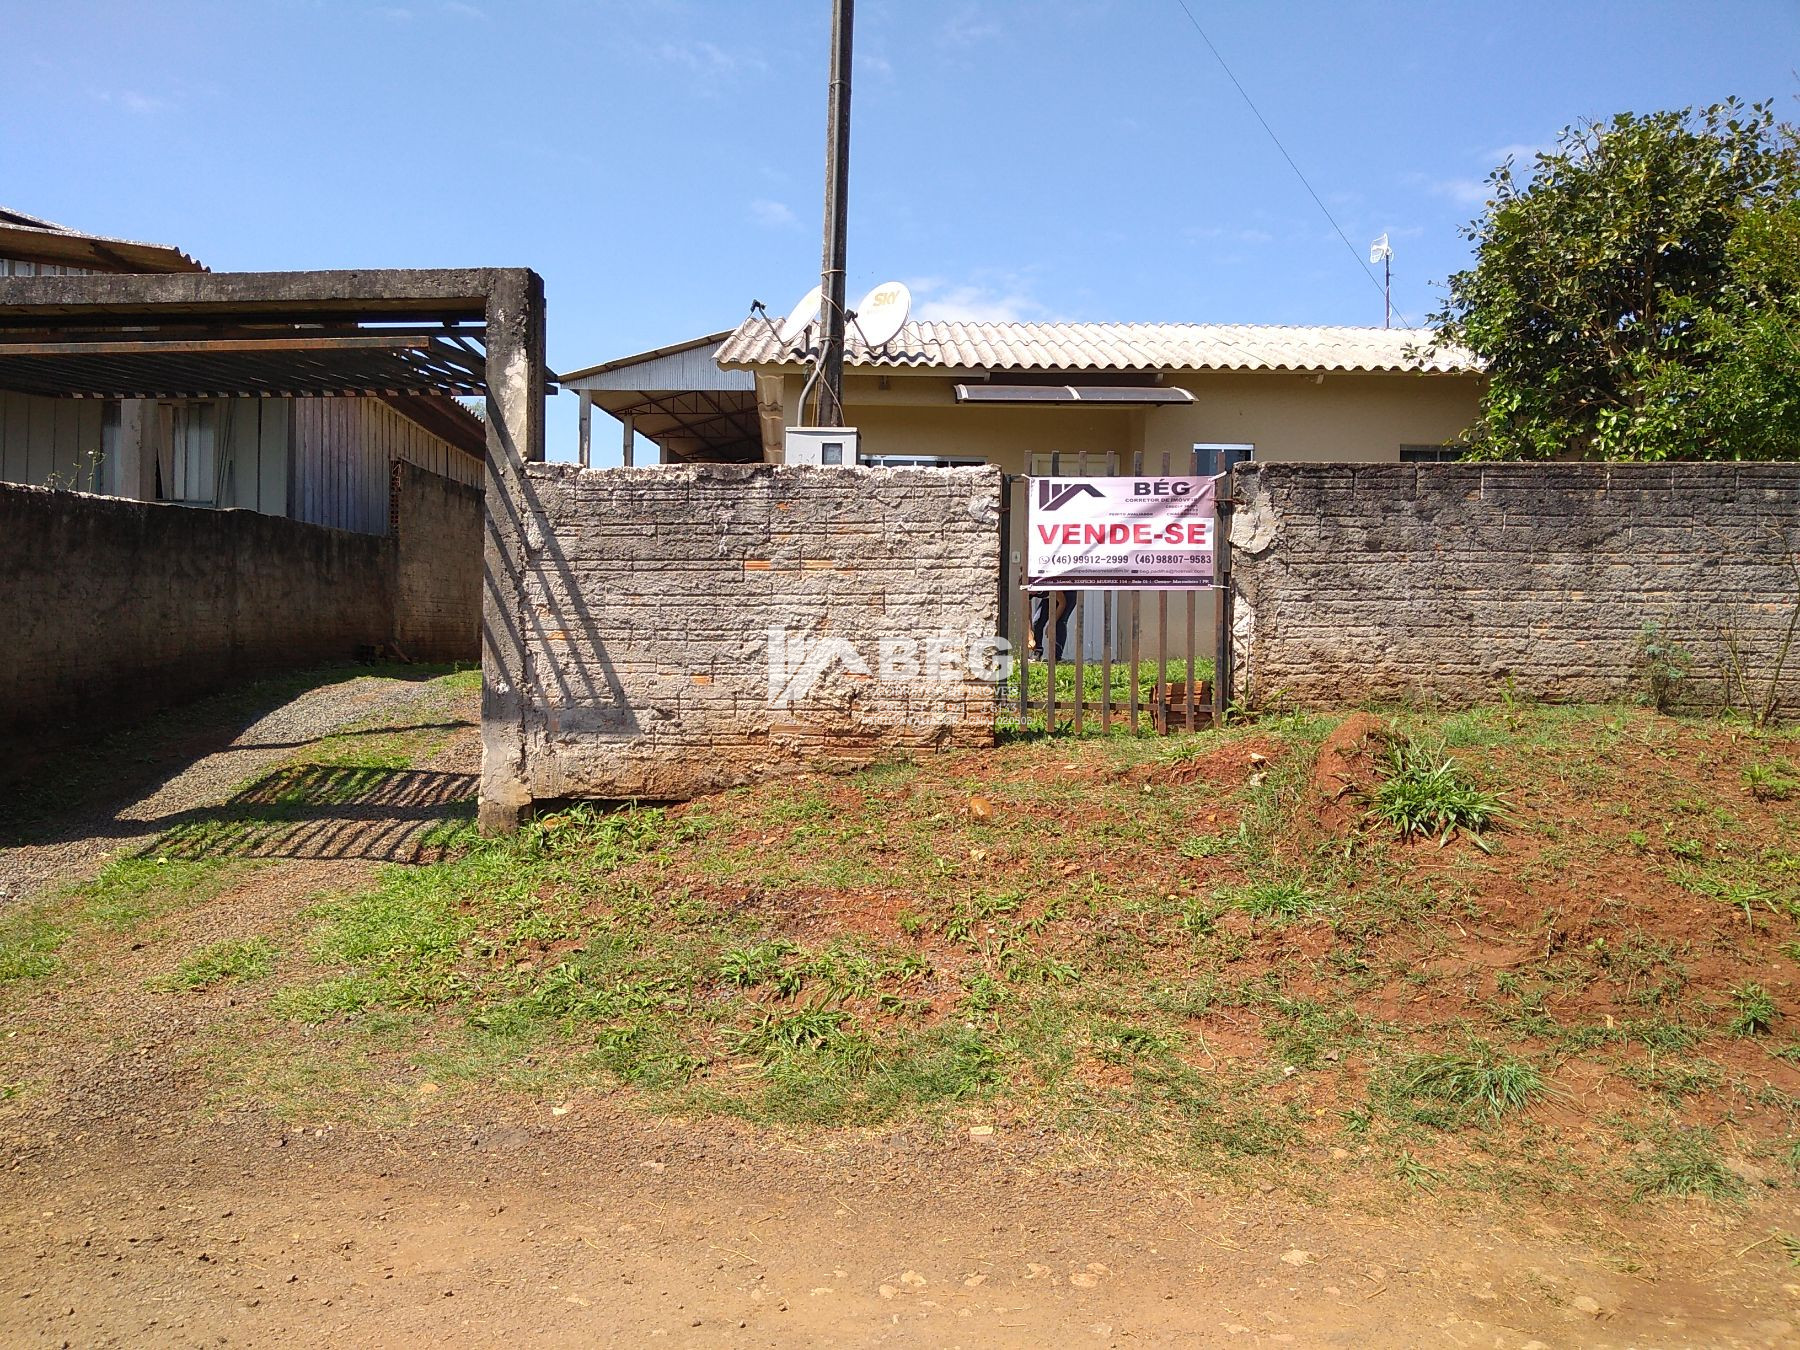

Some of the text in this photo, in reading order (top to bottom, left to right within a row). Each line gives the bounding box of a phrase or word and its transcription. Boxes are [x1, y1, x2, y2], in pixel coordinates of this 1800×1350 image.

[872, 290, 901, 307] SKY
[1134, 478, 1190, 496] BÉG
[1037, 523, 1206, 545] VENDE-SE
[1135, 554, 1212, 565] (46)98807-9583
